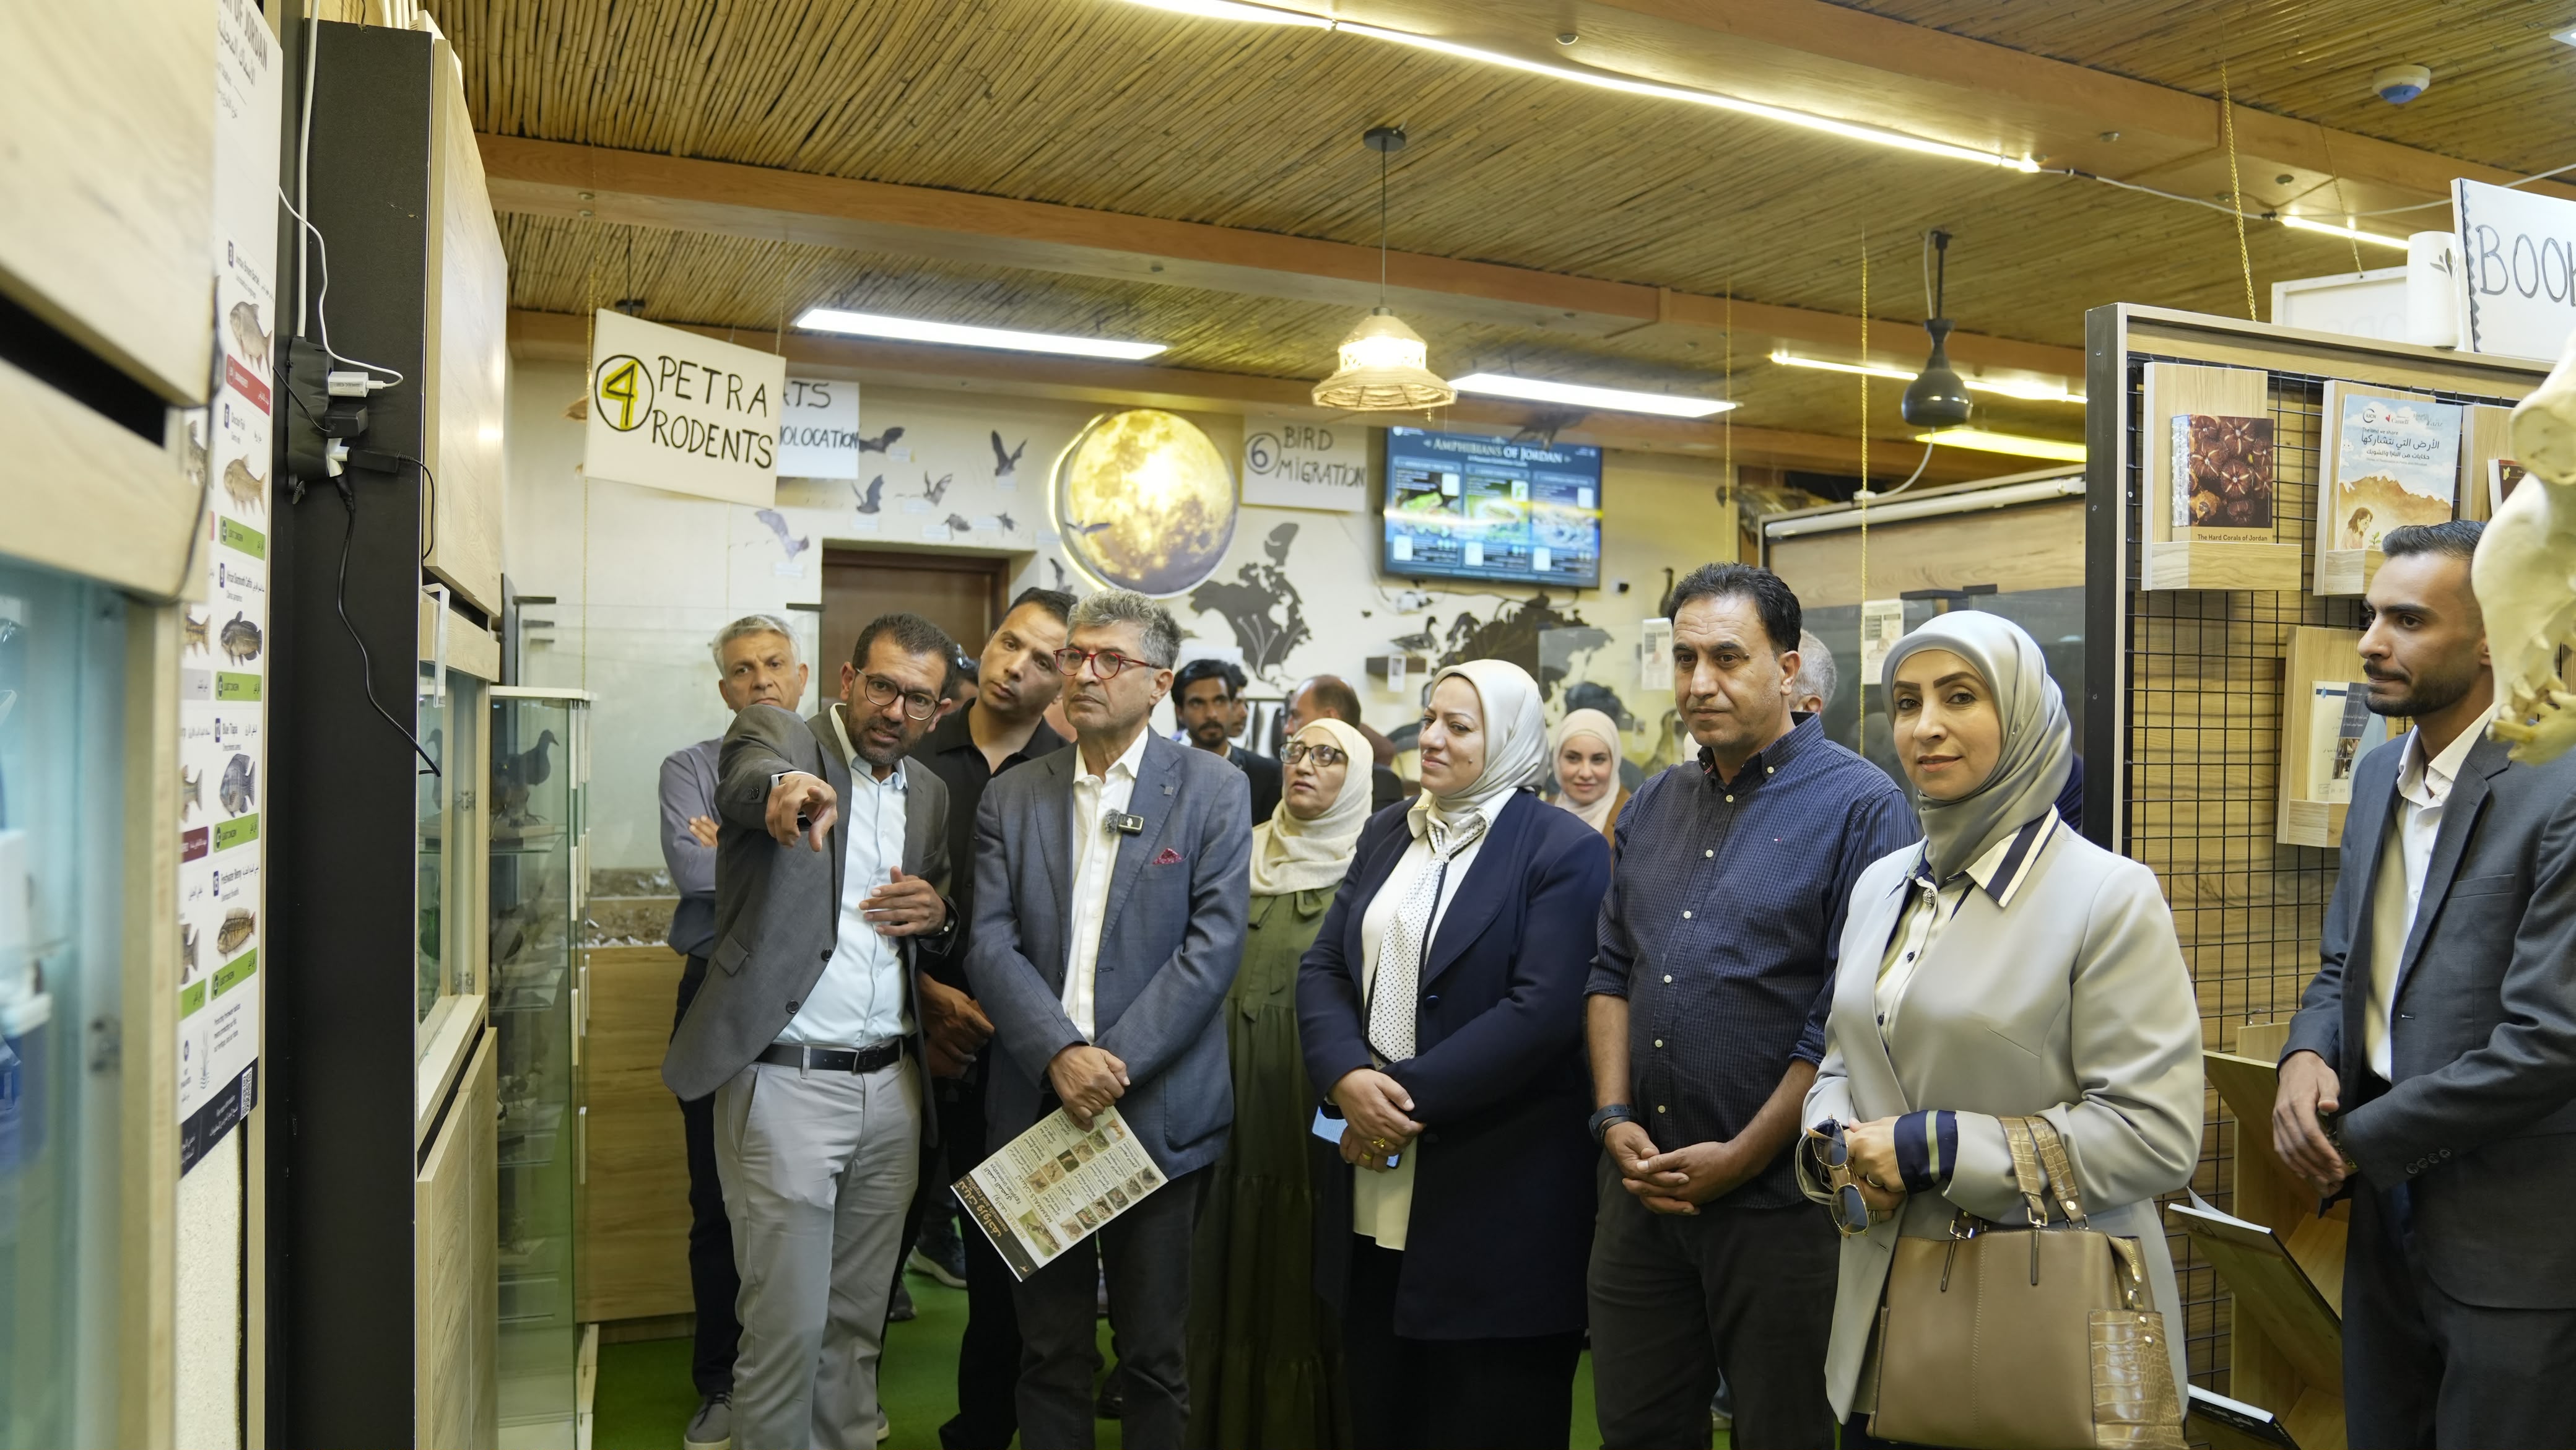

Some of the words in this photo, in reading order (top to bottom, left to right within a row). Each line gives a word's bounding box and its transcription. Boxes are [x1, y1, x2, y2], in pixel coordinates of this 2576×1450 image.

[244, 7, 268, 71] JORDAN
[605, 360, 637, 428] 4
[658, 355, 767, 418] PETRA
[653, 410, 773, 469] RODENTS
[2361, 432, 2394, 446] نتشاركها
[2396, 438, 2411, 450] التي
[2413, 438, 2440, 451] الأرض
[1251, 437, 1270, 469] 6
[1520, 446, 1564, 463] JORDAN
[965, 1175, 982, 1197] reptiles
[983, 1166, 997, 1182] الضب
[994, 1182, 1012, 1200] المصري
[990, 1163, 1007, 1186] Uromastyx
[979, 1196, 990, 1207] and
[993, 1194, 1007, 1212] زواحف
[1006, 1185, 1021, 1204] Egyptian
[977, 1204, 1001, 1236] وزواحف
[988, 1206, 1009, 1232] mammals
[1029, 1193, 1052, 1223] MAMMALS
[1005, 1213, 1026, 1239] REPTILES
